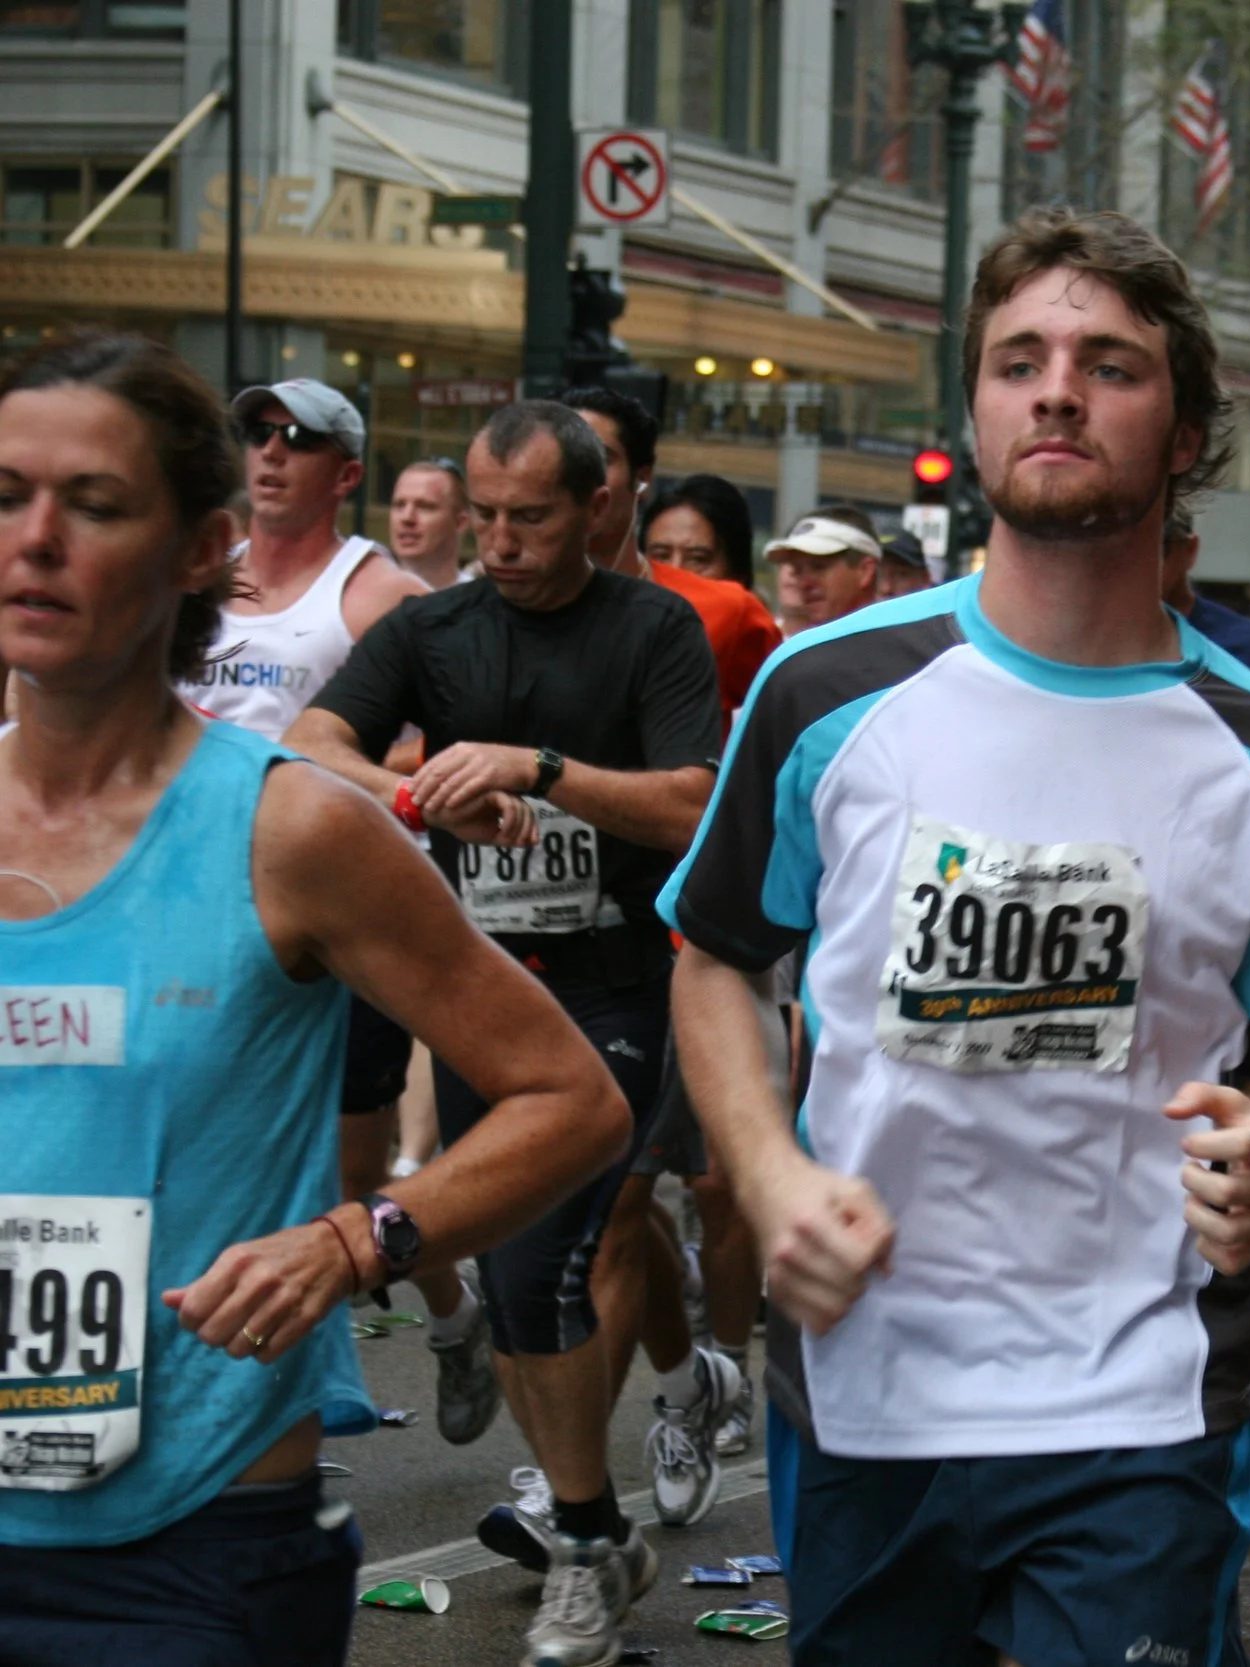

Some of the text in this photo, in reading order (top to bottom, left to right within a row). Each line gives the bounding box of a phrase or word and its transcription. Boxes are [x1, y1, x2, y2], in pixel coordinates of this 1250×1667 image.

[201, 171, 484, 247] SEAR
[496, 829, 593, 883] 8786
[1059, 860, 1114, 883] Bank
[905, 883, 1129, 985] 39063
[0, 997, 89, 1048] EEN
[40, 1219, 100, 1243] Bank
